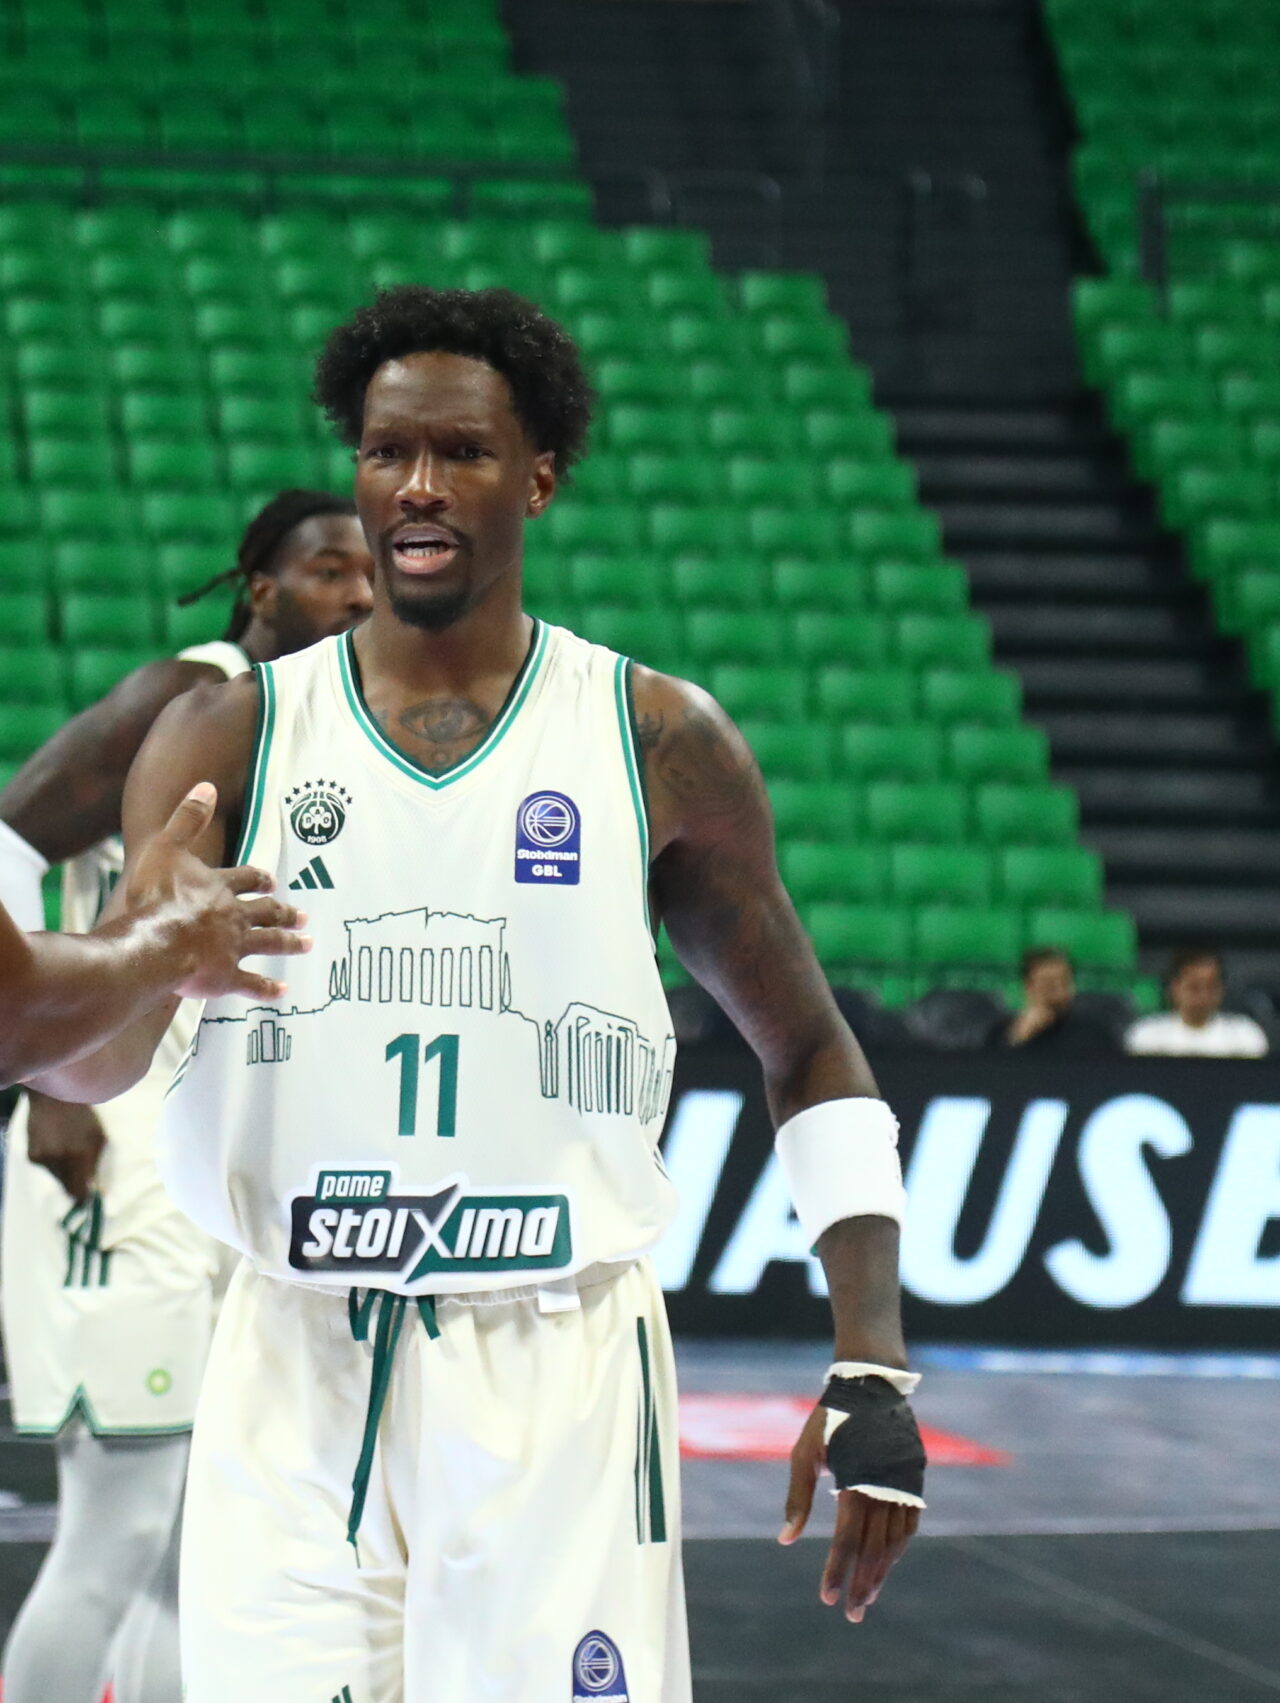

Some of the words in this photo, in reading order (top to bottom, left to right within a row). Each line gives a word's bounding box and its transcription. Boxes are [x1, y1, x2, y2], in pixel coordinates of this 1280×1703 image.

[531, 864, 563, 877] GBL
[384, 1034, 460, 1138] 11
[321, 1175, 385, 1200] pame
